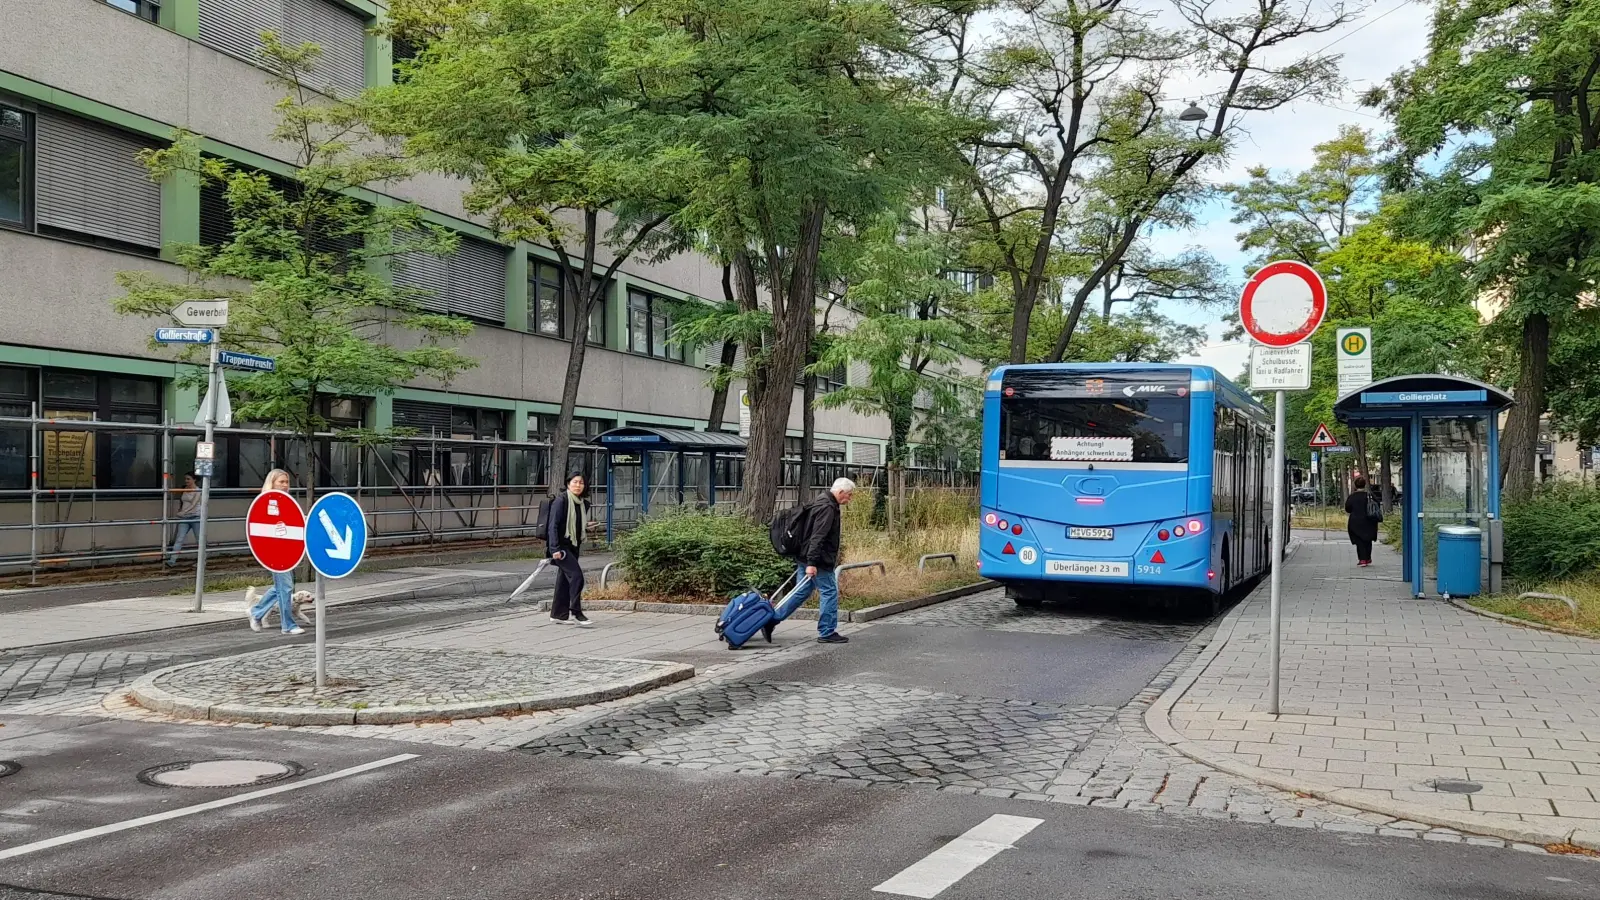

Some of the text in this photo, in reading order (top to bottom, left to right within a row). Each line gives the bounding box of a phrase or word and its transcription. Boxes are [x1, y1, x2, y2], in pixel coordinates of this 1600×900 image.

[159, 329, 207, 342] Gollierstraße
[1348, 337, 1360, 351] H
[221, 352, 273, 370] Trappentreustr.
[1136, 385, 1166, 393] MVG
[1398, 393, 1447, 402] Gollierplatz
[1056, 449, 1085, 457] Anhänger
[1086, 449, 1115, 457] schwenkt
[1022, 550, 1033, 561] 80
[1053, 562, 1097, 574] Überlänge!
[1100, 565, 1110, 573] 23
[1137, 565, 1161, 575] 5914
